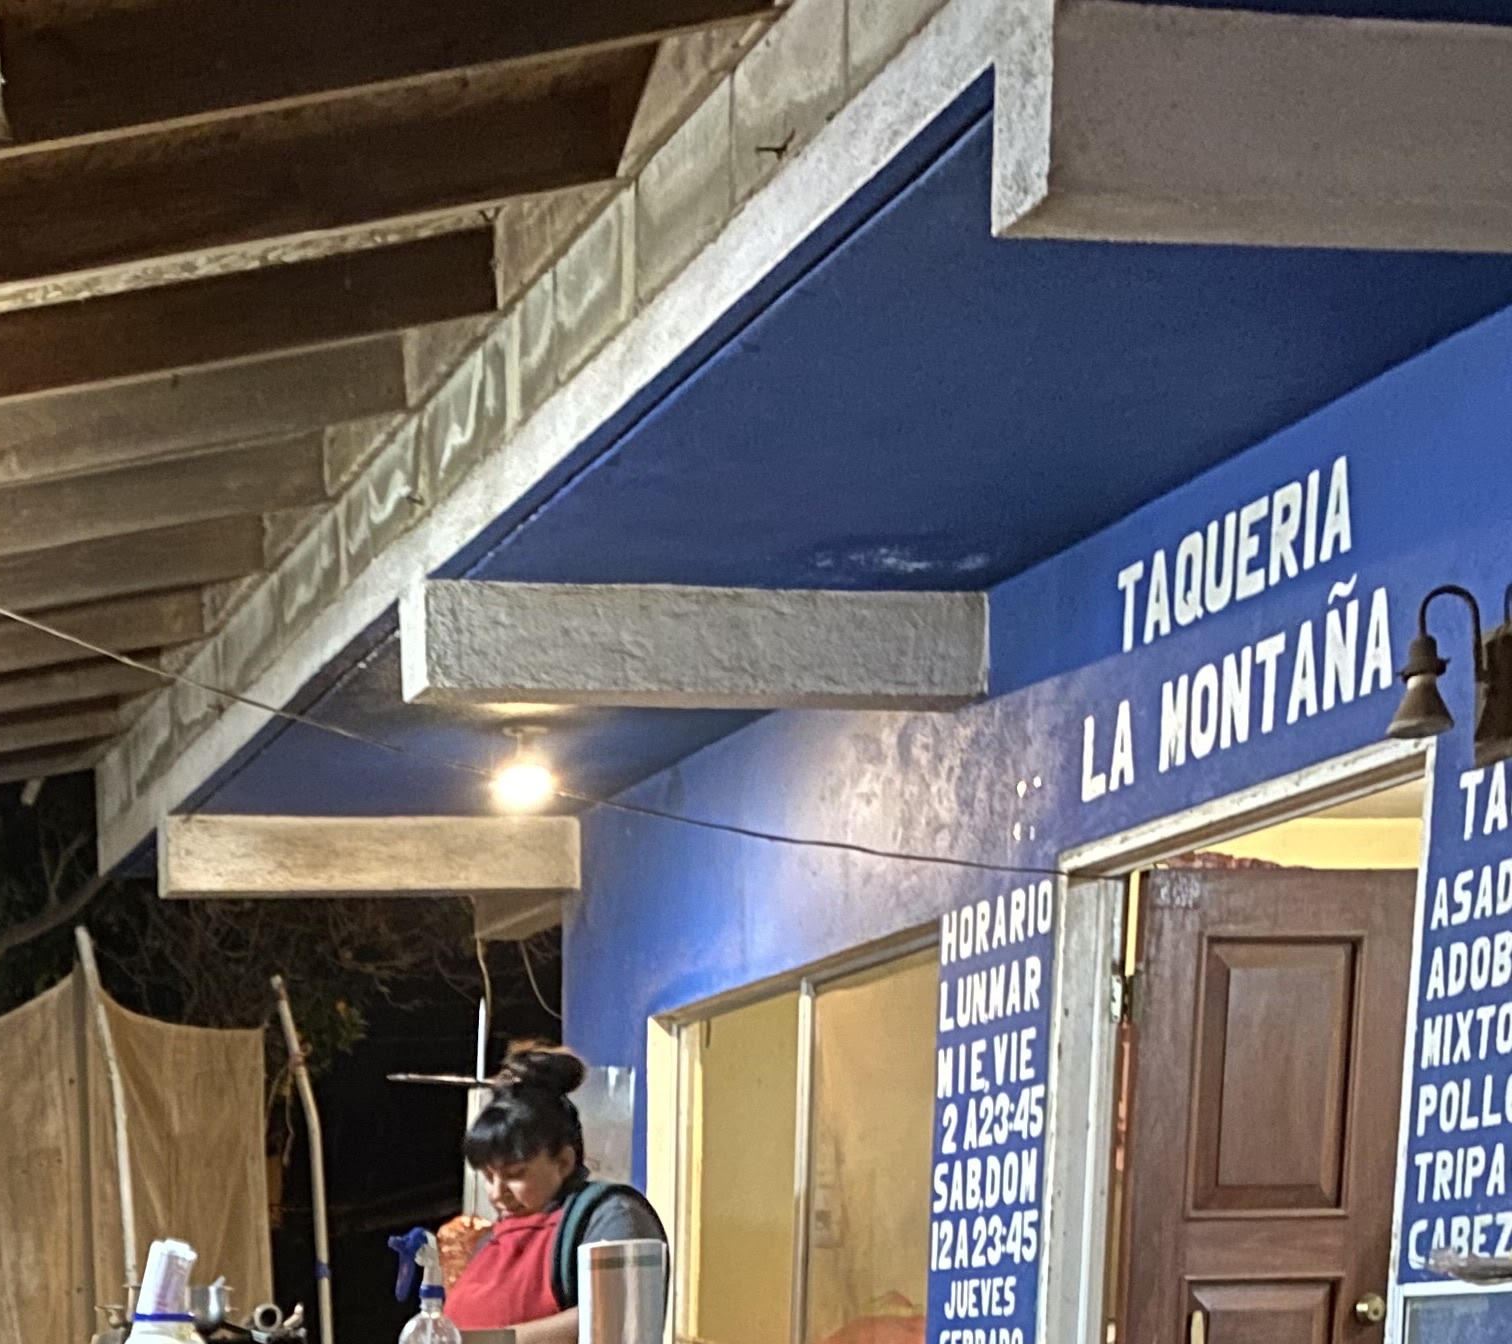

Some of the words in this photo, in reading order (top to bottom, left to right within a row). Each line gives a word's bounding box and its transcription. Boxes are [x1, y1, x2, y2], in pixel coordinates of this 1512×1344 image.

[1117, 455, 1352, 653] TAQUERIA
[1081, 699, 1135, 803] LA
[1157, 572, 1394, 774] MONTAÑA
[1459, 760, 1512, 842] TA
[941, 880, 1053, 967] HORARIO
[1420, 1002, 1512, 1071] MIXTO
[1414, 1142, 1506, 1204] TRIPA
[944, 1275, 1017, 1320] JUEVES
